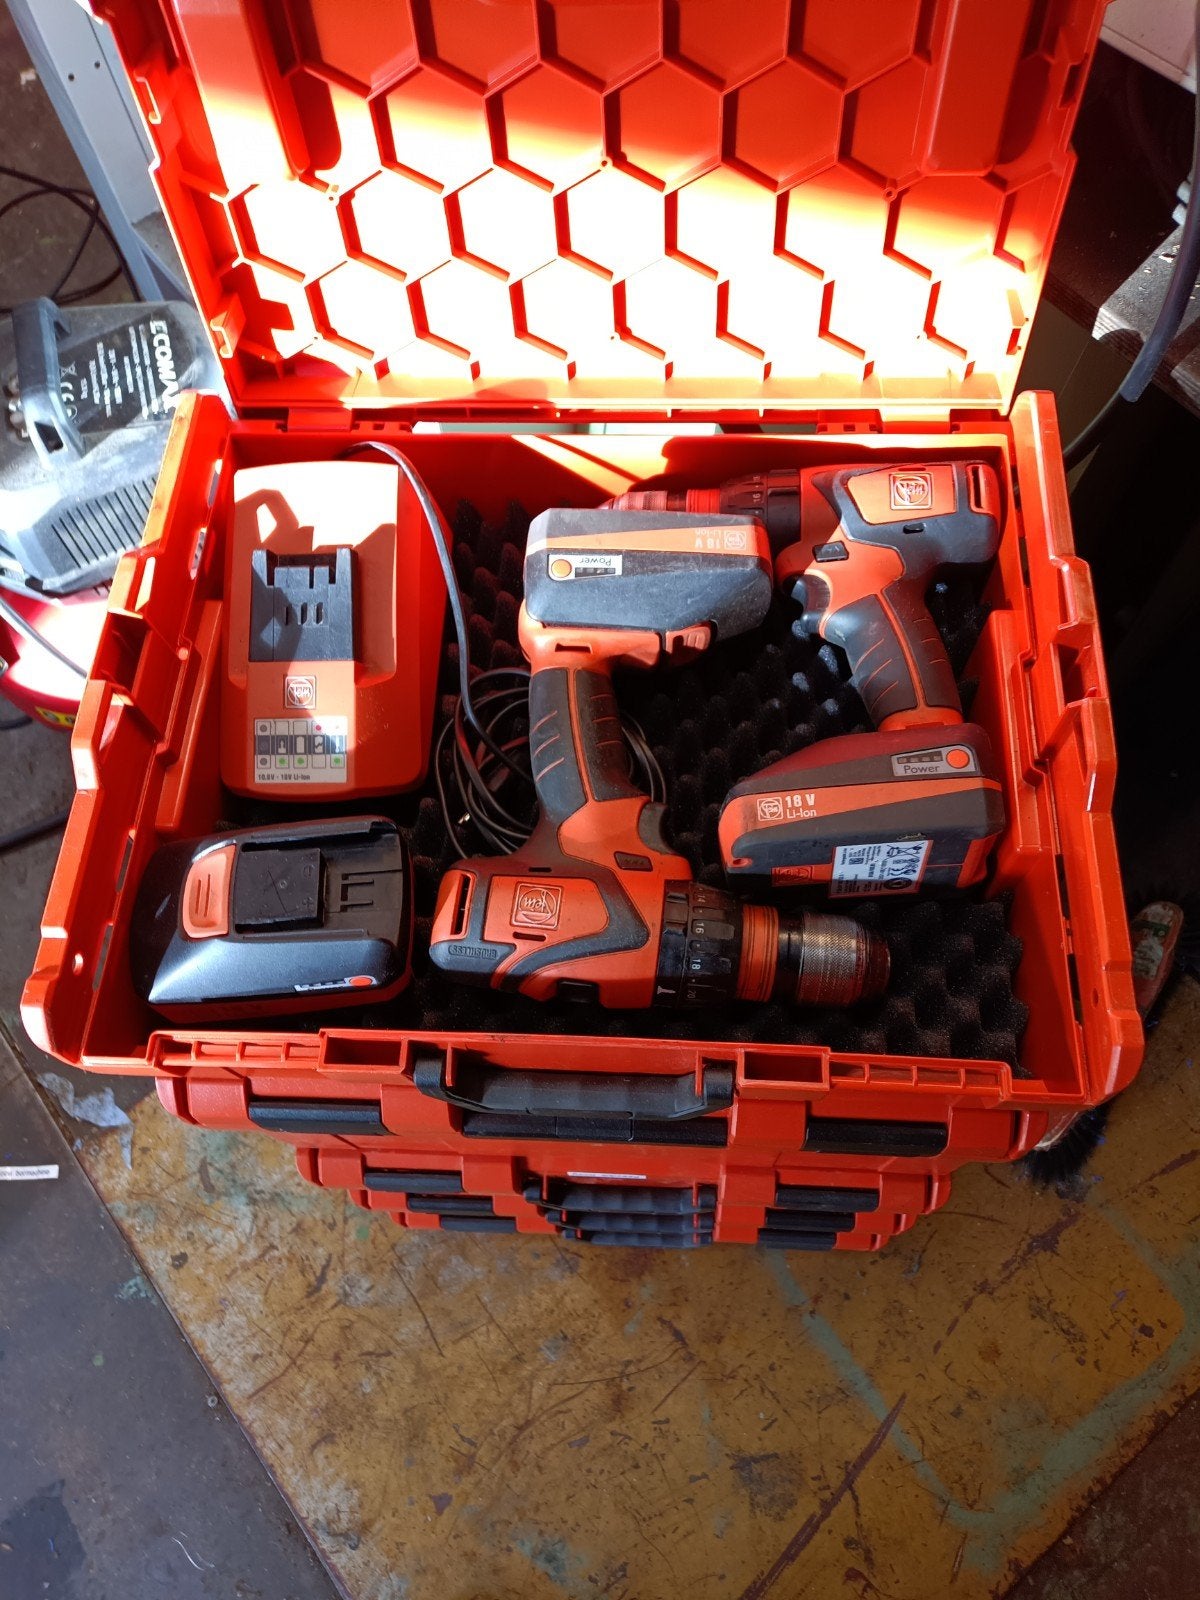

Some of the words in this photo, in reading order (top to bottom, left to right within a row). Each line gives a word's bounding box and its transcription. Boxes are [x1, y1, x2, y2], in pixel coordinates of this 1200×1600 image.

[579, 556, 612, 567] Power
[903, 764, 941, 775] Power
[785, 795, 803, 809] 18
[806, 794, 816, 807] V
[786, 808, 818, 820] Li-Ion
[695, 922, 705, 934] 16
[450, 945, 497, 960] BRUSHLESS
[691, 958, 701, 970] 18
